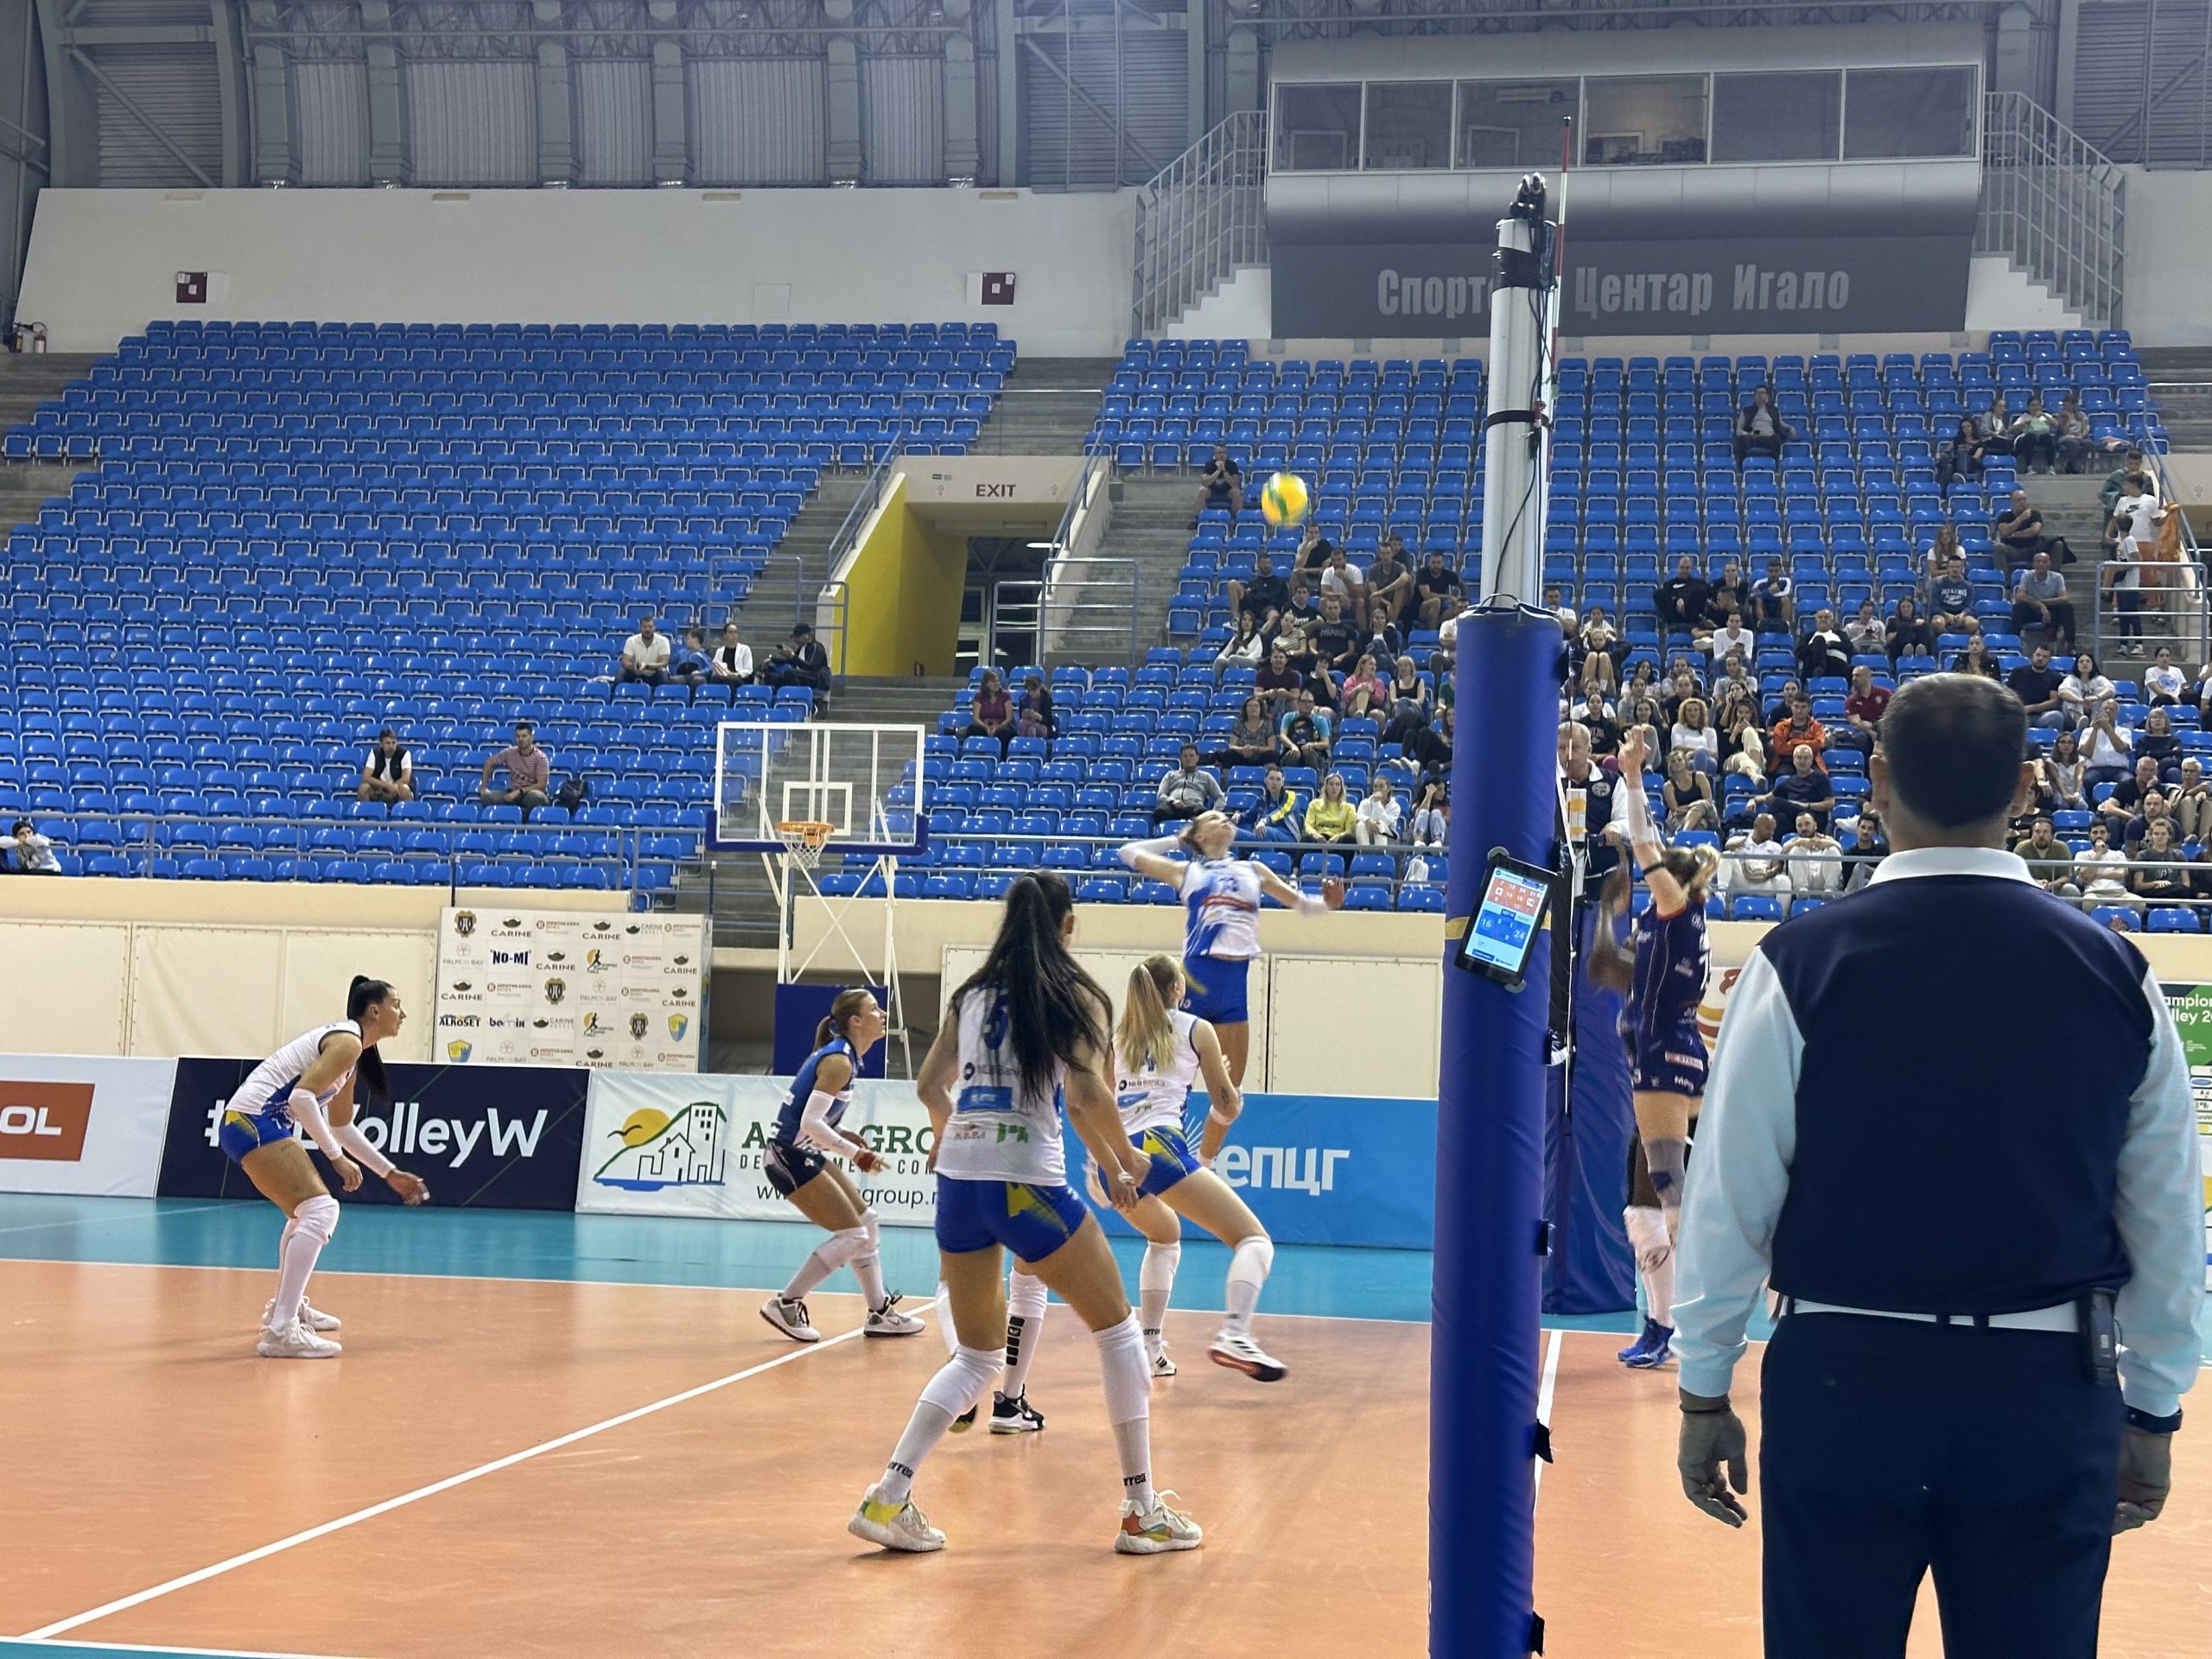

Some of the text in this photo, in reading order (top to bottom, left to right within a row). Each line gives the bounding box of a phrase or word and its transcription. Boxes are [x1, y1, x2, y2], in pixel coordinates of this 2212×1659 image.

[1377, 264, 1850, 320] Спорт Центар Игало
[976, 484, 1016, 498] EXIT
[441, 993, 483, 1001] CARINE
[2164, 995, 2212, 1009] ampio
[2171, 1008, 2198, 1026] lley
[575, 1060, 613, 1069] CARINE
[0, 1105, 62, 1136] OL
[859, 1124, 935, 1155] GRO
